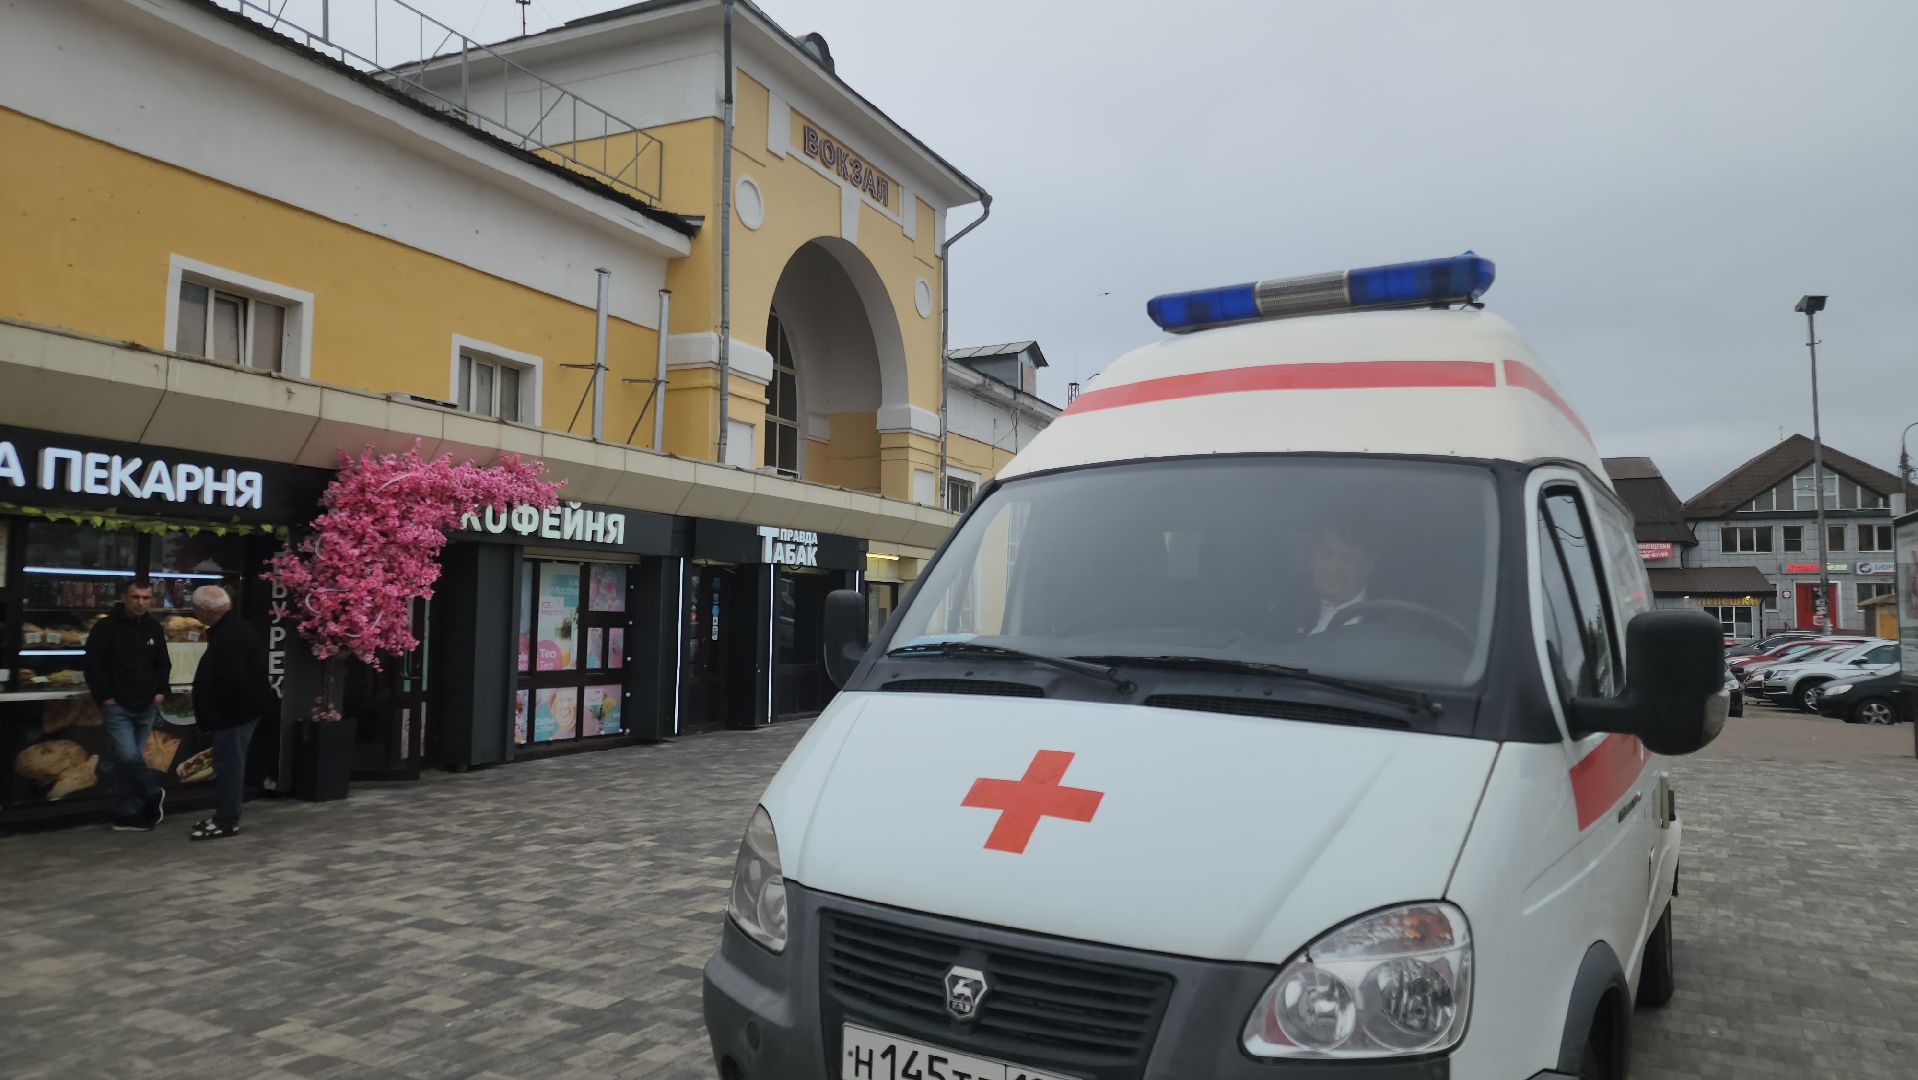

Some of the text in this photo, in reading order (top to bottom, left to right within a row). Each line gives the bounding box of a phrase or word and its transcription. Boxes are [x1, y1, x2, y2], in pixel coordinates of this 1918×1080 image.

[803, 124, 888, 207] ВОКЗАЛ
[38, 446, 263, 510] ПЕКАРНЯ
[757, 525, 818, 567] ТАБАК
[779, 527, 818, 545] ПРАВДА
